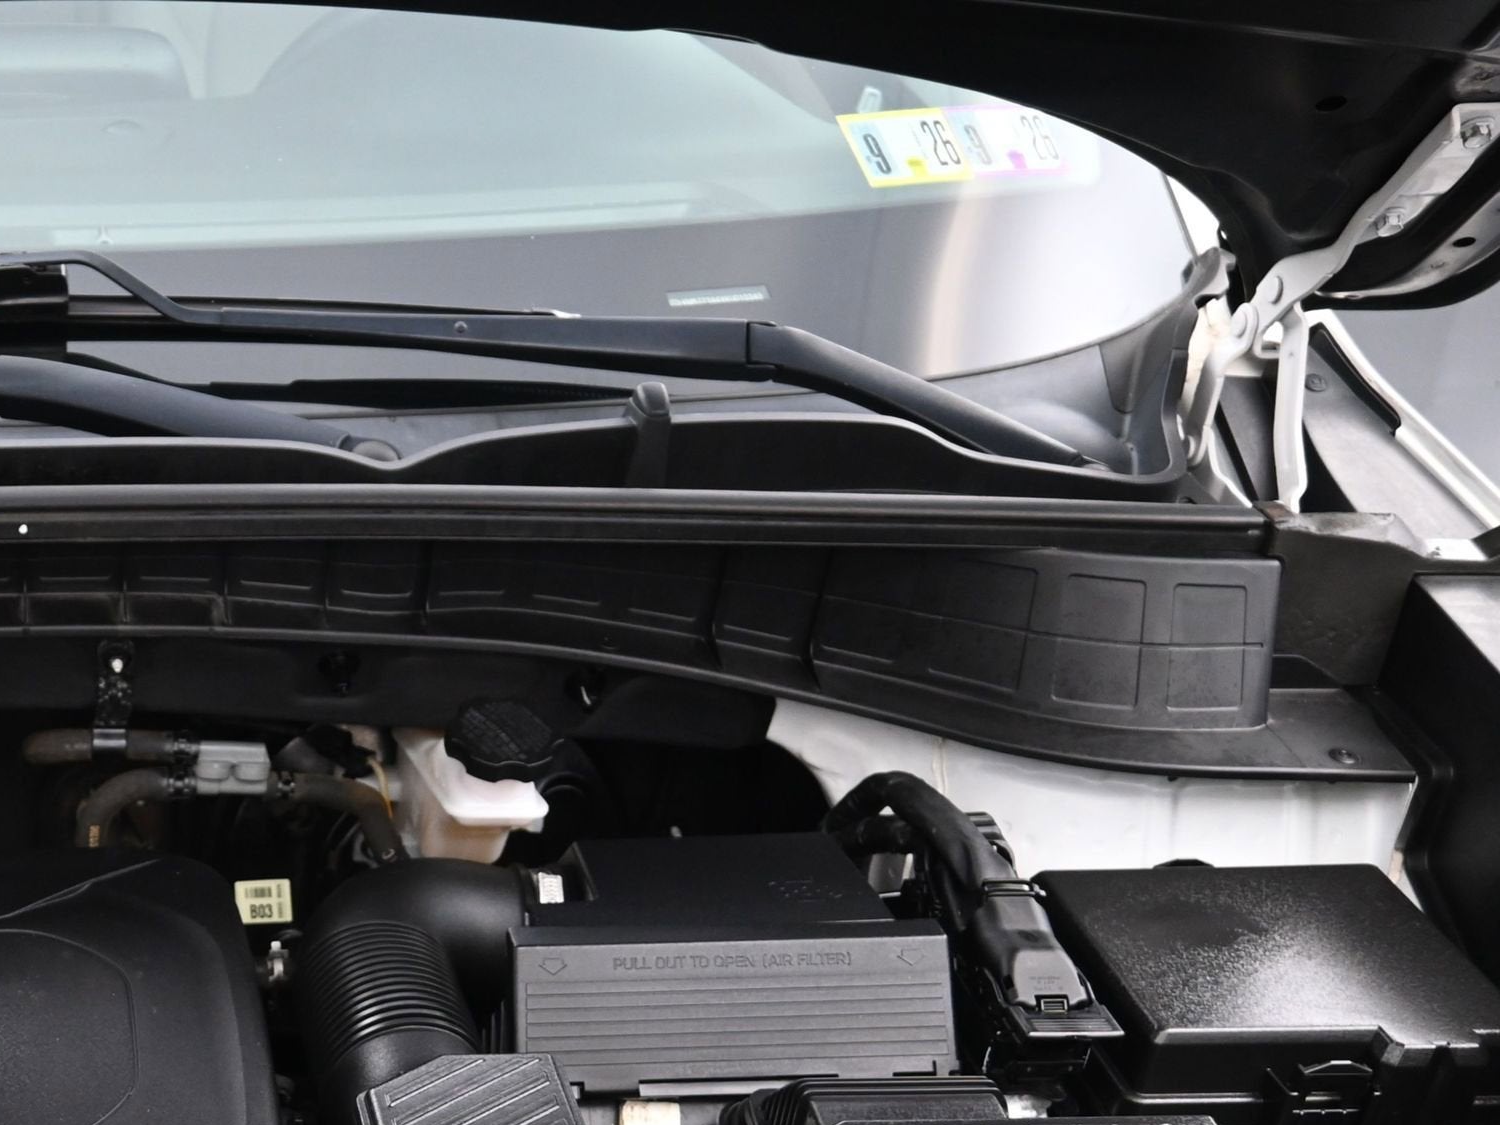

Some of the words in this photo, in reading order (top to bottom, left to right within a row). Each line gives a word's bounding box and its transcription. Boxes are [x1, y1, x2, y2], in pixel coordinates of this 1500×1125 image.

[863, 133, 891, 175] 9
[920, 120, 961, 165] 26
[1021, 115, 1059, 160] 26
[250, 903, 273, 919] B03
[613, 957, 651, 970] PULL
[655, 955, 684, 969] OUT
[690, 955, 709, 969] TO
[714, 954, 754, 968] OPEN
[763, 953, 792, 968] (AIR
[798, 951, 852, 967] FILTER)
